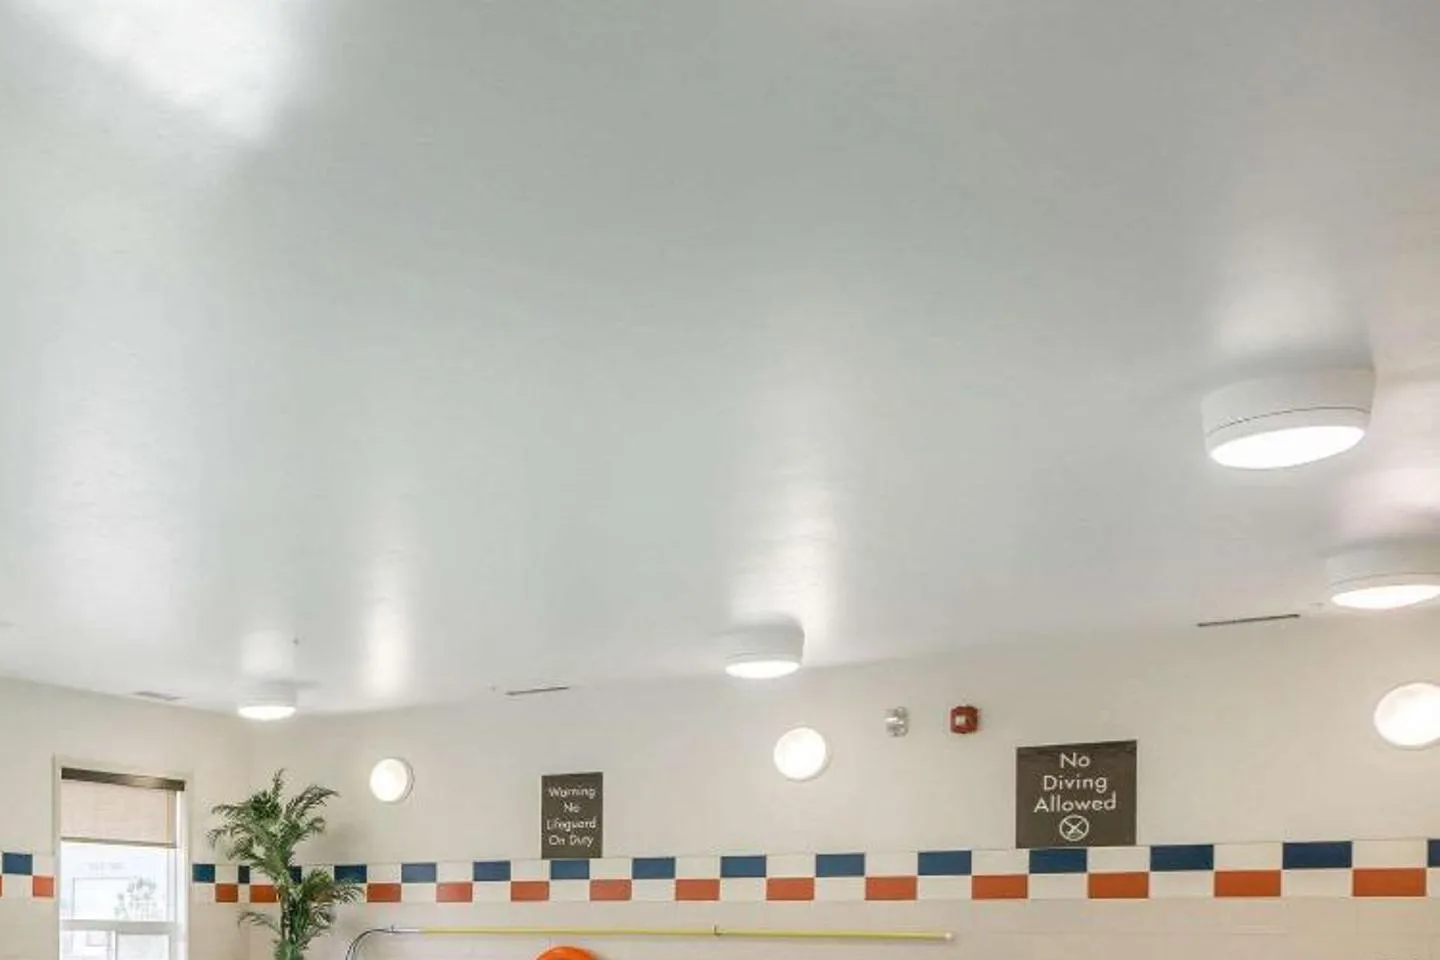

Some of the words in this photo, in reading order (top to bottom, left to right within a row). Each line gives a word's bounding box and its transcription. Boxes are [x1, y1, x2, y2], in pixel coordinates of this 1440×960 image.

[1060, 752, 1091, 768] No
[1044, 773, 1108, 793] Diving
[548, 785, 596, 800] Warning
[1033, 790, 1117, 813] Allowed
[548, 834, 565, 845] On
